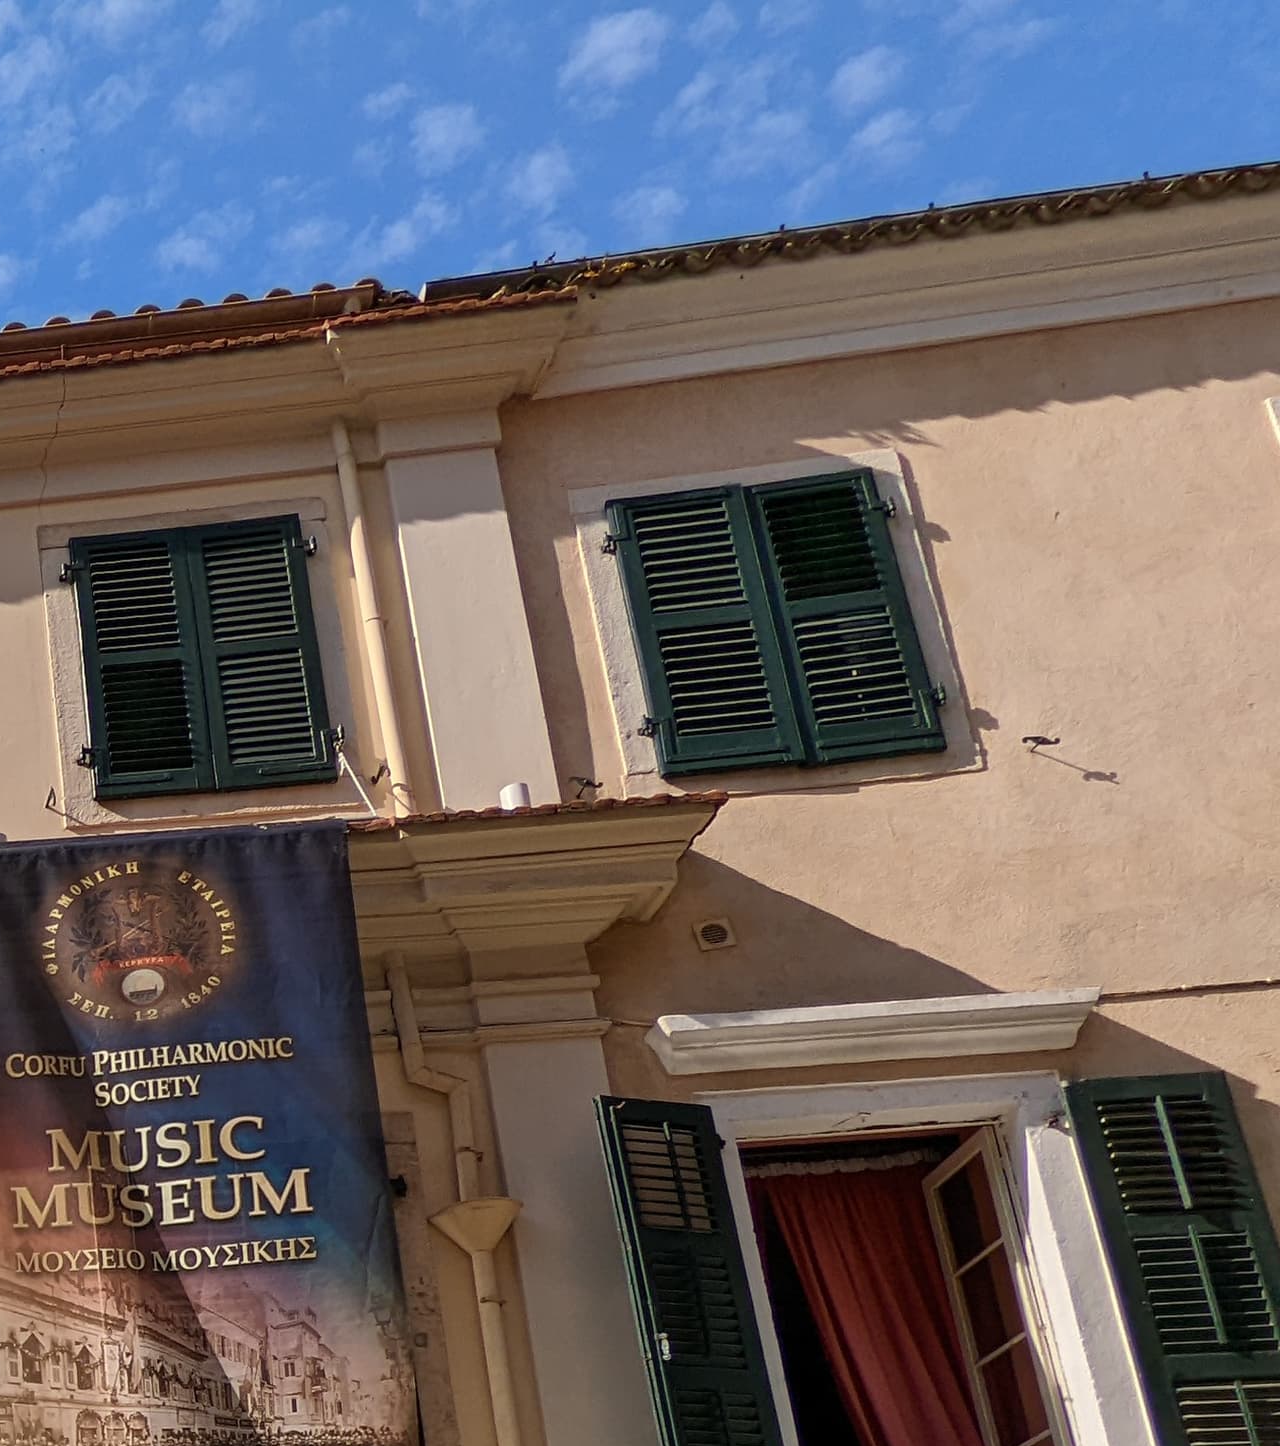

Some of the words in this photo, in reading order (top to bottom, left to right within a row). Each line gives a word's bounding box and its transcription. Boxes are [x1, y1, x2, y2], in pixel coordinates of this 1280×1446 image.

[42, 861, 140, 975] ΦΙΛΑΡΜΟΝΙΚΗ
[177, 870, 236, 956] ΕΤΑΙΡΕΙΑ
[134, 1008, 159, 1022] 12
[180, 975, 221, 1009] 1840
[45, 1115, 266, 1174] MUSIC
[10, 1167, 314, 1229] MUSEUM
[15, 1248, 145, 1274] ΜΟΥΣΕΙΟ
[152, 1236, 317, 1272] ΜΟΥΣΙΚΗΣ
